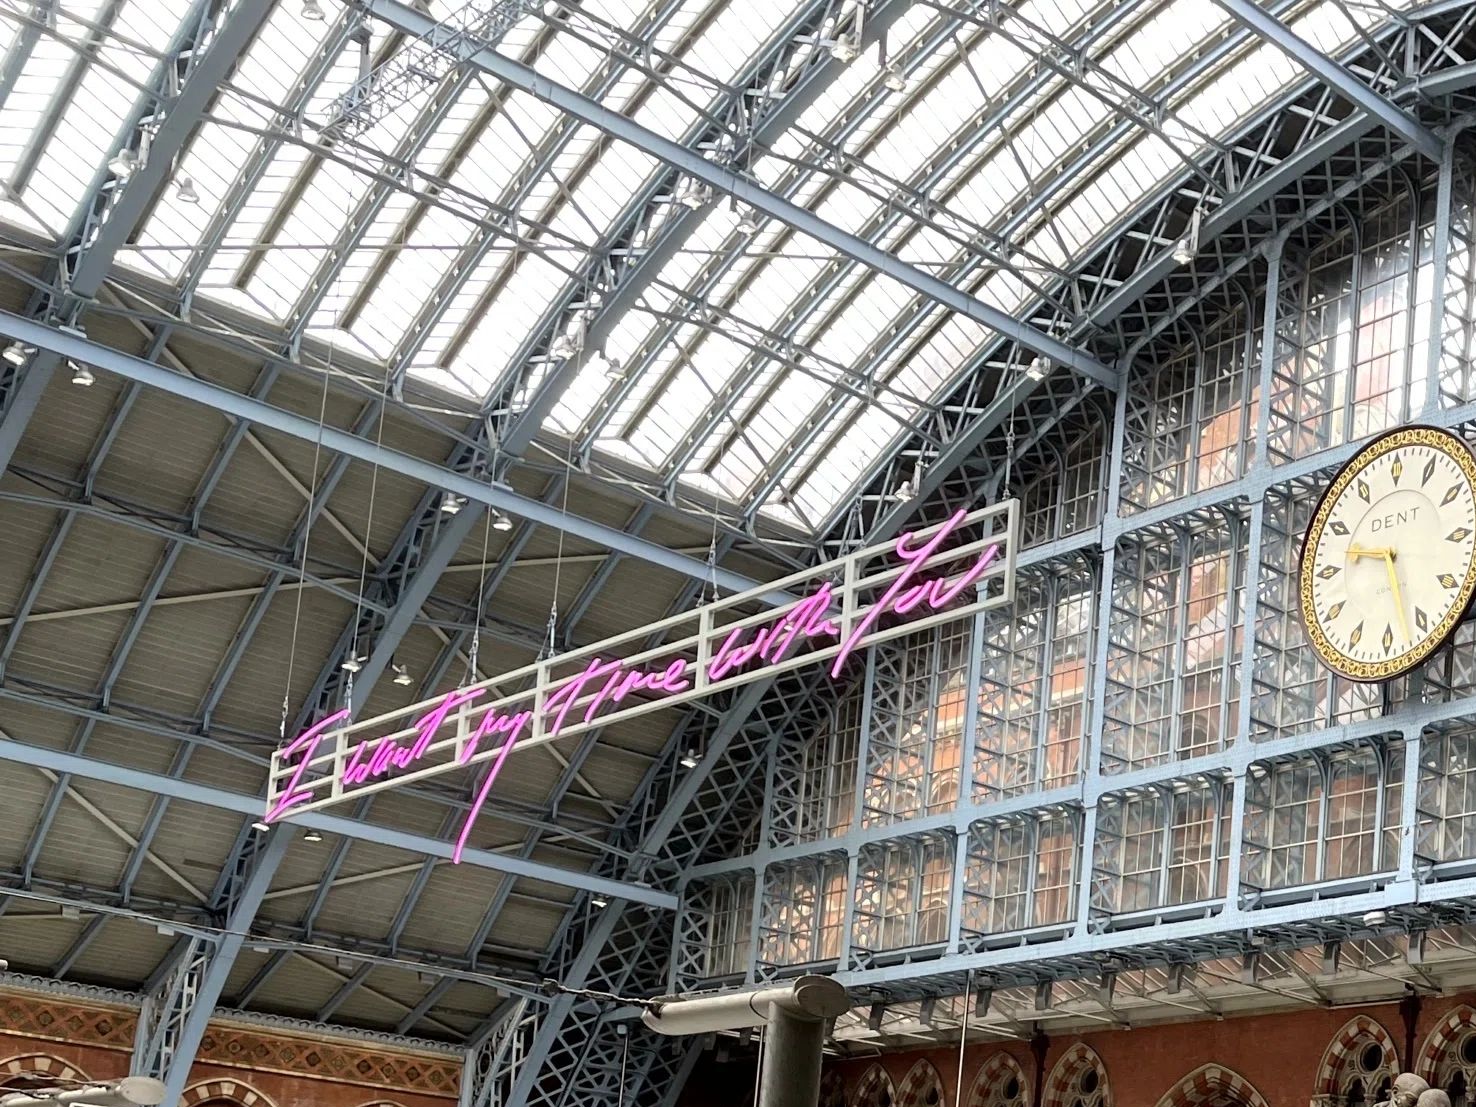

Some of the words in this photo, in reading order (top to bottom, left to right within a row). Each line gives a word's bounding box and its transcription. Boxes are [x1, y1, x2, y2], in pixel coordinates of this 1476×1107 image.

[1371, 507, 1420, 532] DENT
[265, 709, 349, 822] I
[342, 689, 485, 786] want
[451, 708, 533, 864] my
[708, 582, 840, 677] with
